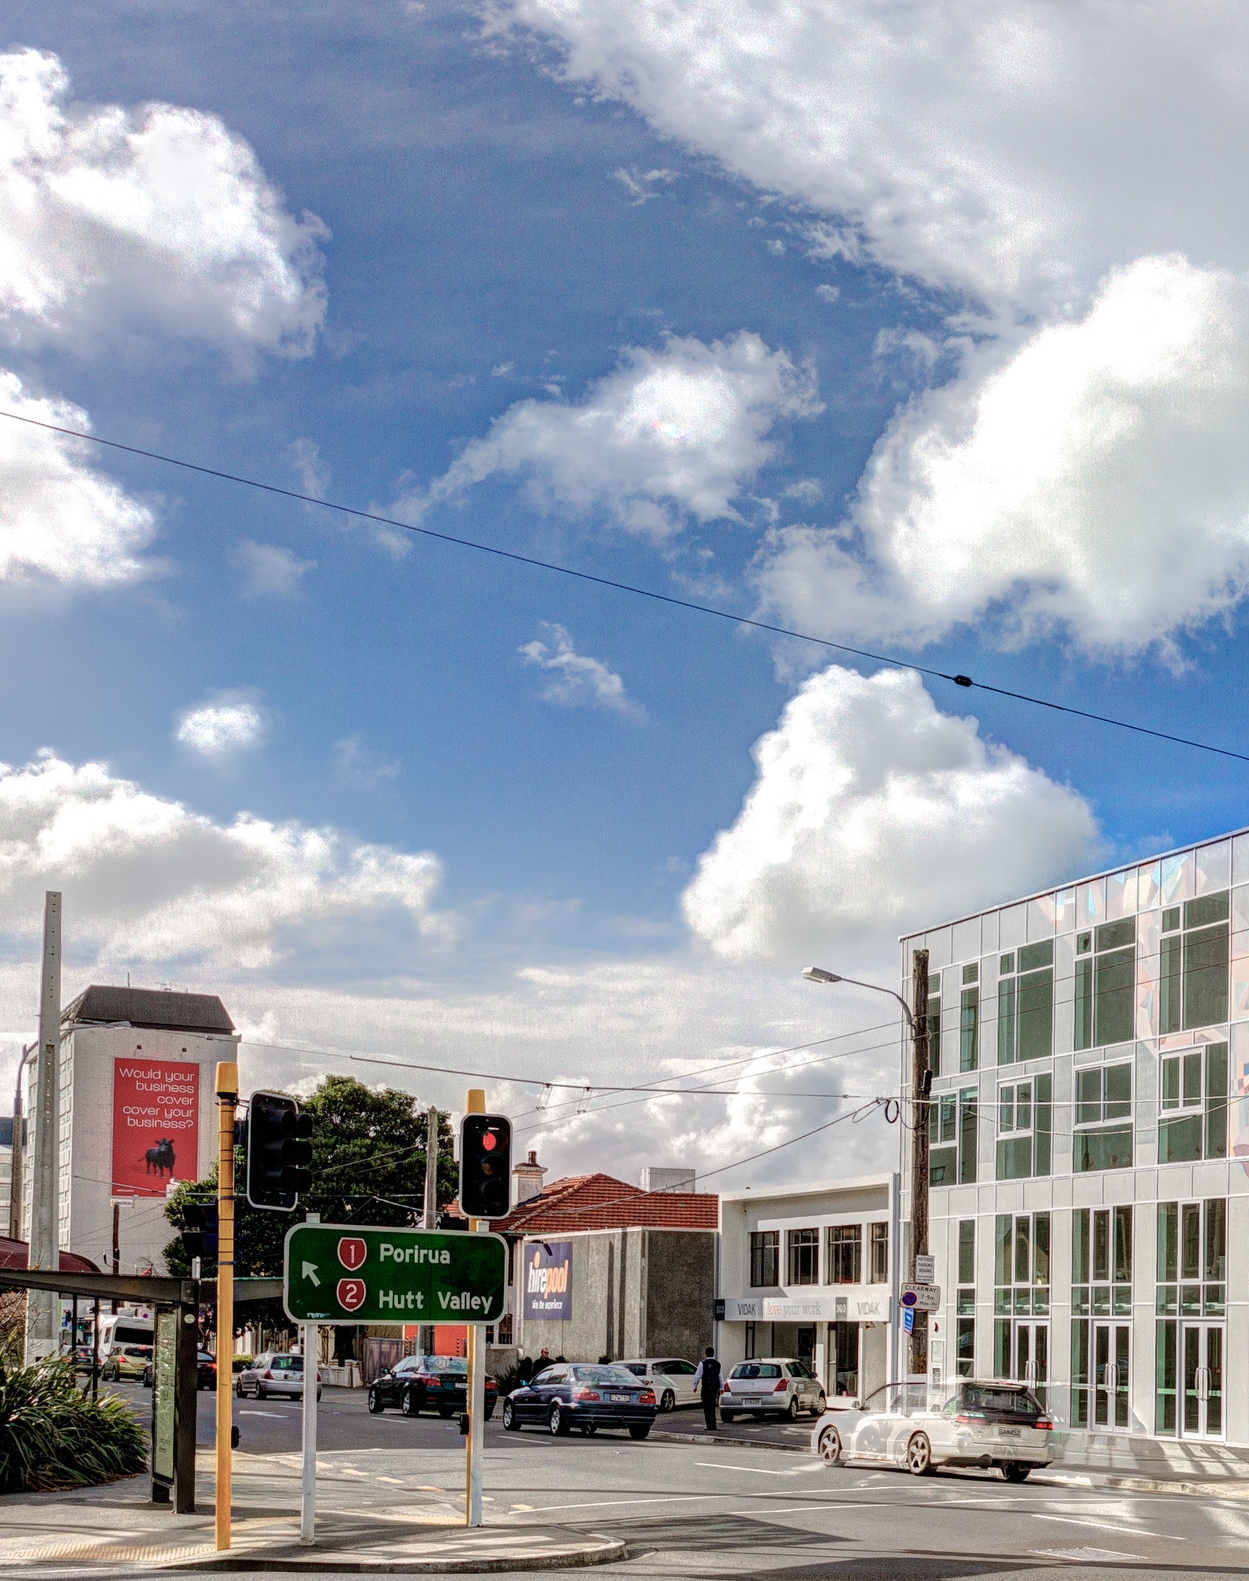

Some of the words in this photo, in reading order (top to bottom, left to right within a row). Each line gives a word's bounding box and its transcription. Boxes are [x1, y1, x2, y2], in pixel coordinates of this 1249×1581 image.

[119, 1067, 161, 1080] Would
[164, 1072, 195, 1083] your
[135, 1080, 195, 1094] business
[156, 1095, 195, 1106] cover
[122, 1105, 160, 1116] cover
[164, 1108, 194, 1119] your
[127, 1116, 194, 1129] business?
[348, 1244, 356, 1264] 1
[379, 1243, 450, 1265] Porirua
[527, 1251, 569, 1299] hirepool
[345, 1283, 358, 1303] 2
[905, 1284, 937, 1293] CLEARWAY
[378, 1290, 424, 1309] Hutt
[437, 1291, 493, 1314] Valley
[737, 1303, 757, 1316] VIDAK
[767, 1302, 782, 1315] love
[783, 1304, 800, 1318] your
[802, 1302, 821, 1315] work
[857, 1301, 880, 1315] VIDAK
